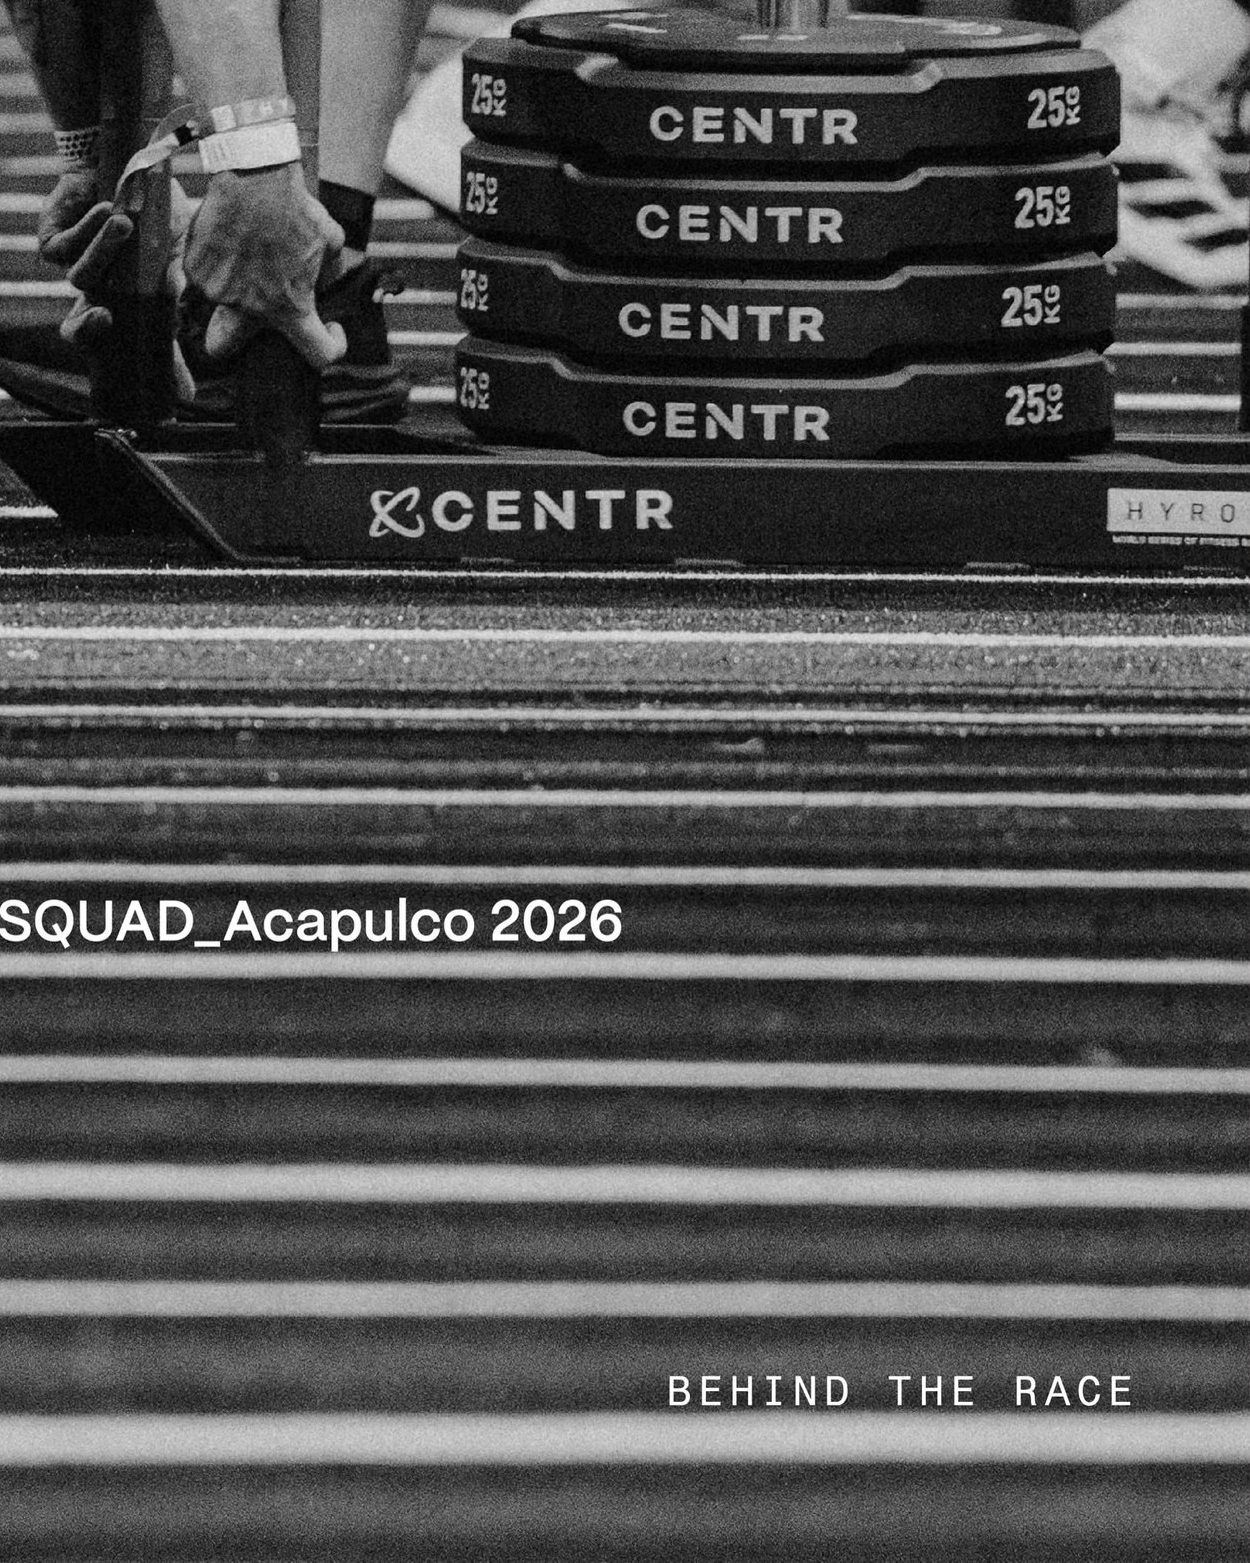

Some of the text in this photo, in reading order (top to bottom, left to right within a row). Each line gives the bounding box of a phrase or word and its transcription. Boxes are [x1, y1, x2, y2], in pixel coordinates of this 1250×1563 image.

[651, 107, 857, 144] CENTR
[637, 205, 842, 243] CENTR
[620, 304, 823, 341] CENTR
[624, 402, 829, 440] CENTR
[433, 489, 673, 532] CENTR
